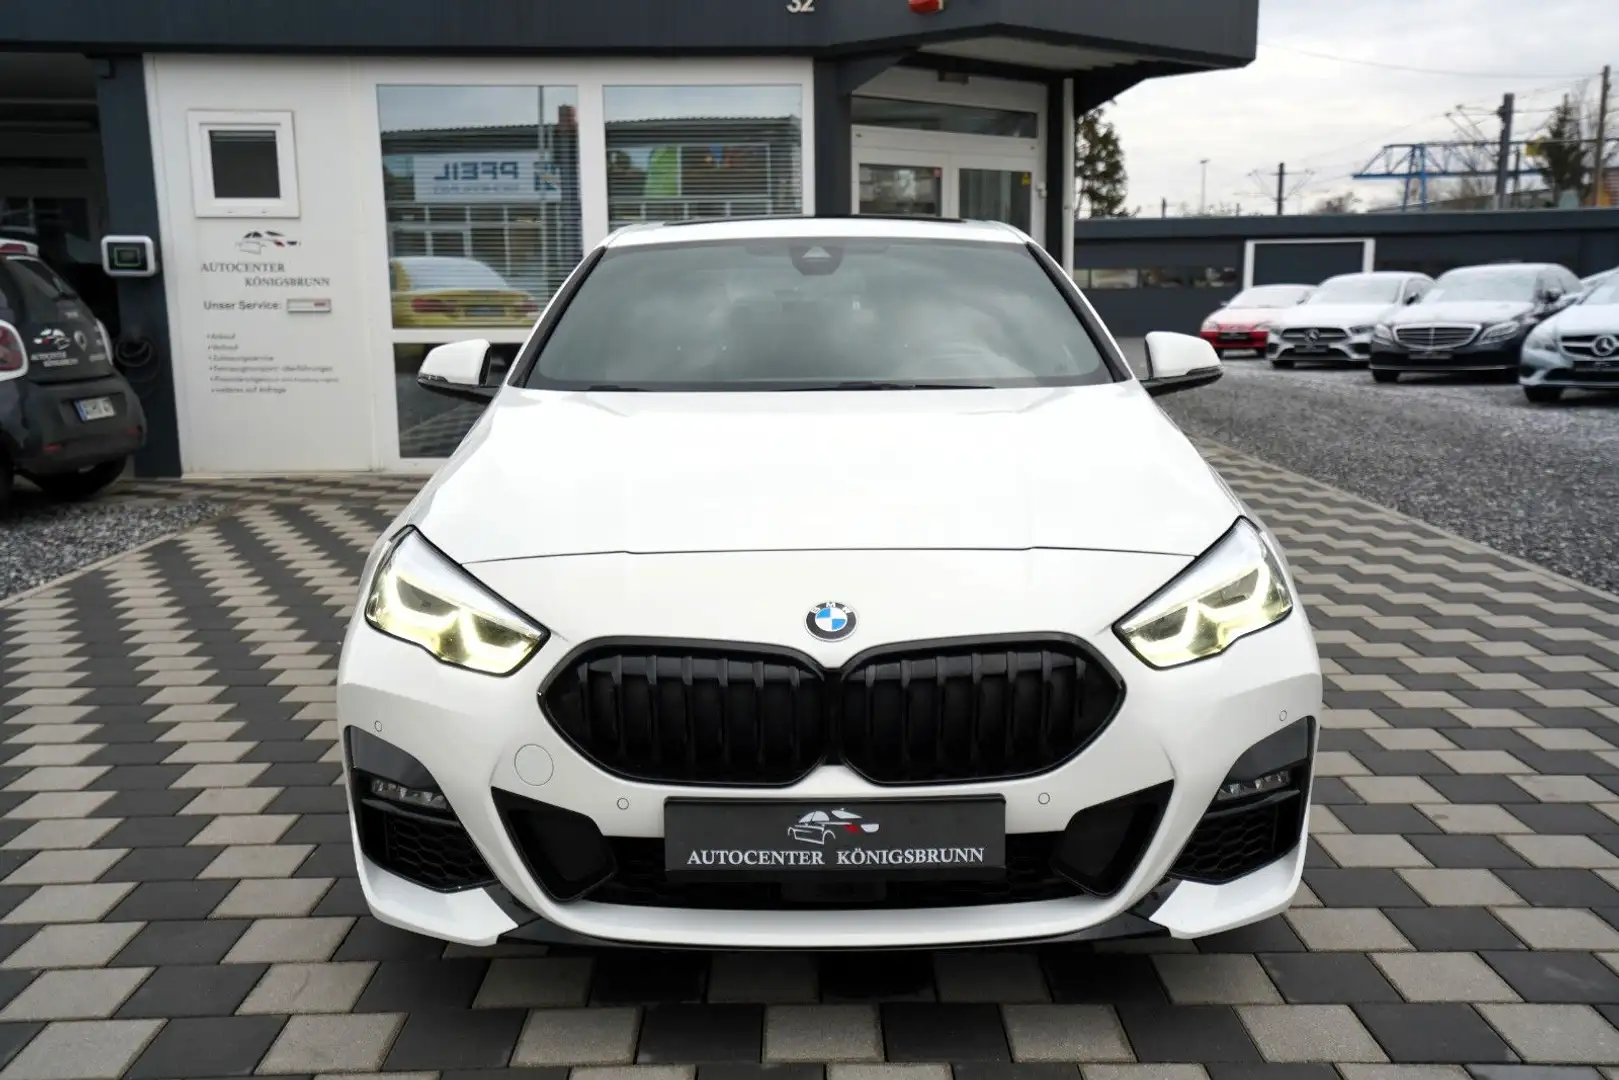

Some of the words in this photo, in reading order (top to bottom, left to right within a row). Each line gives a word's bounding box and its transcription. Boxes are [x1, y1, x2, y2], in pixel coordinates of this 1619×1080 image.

[200, 262, 286, 273] AUTOCENTER
[244, 276, 331, 287] KÖNIGSBRUNN
[203, 301, 235, 310] Unser
[238, 300, 282, 310] Service:
[686, 850, 826, 866] AUTOCENTER
[836, 847, 985, 865] KÖNIGSBRUNN
